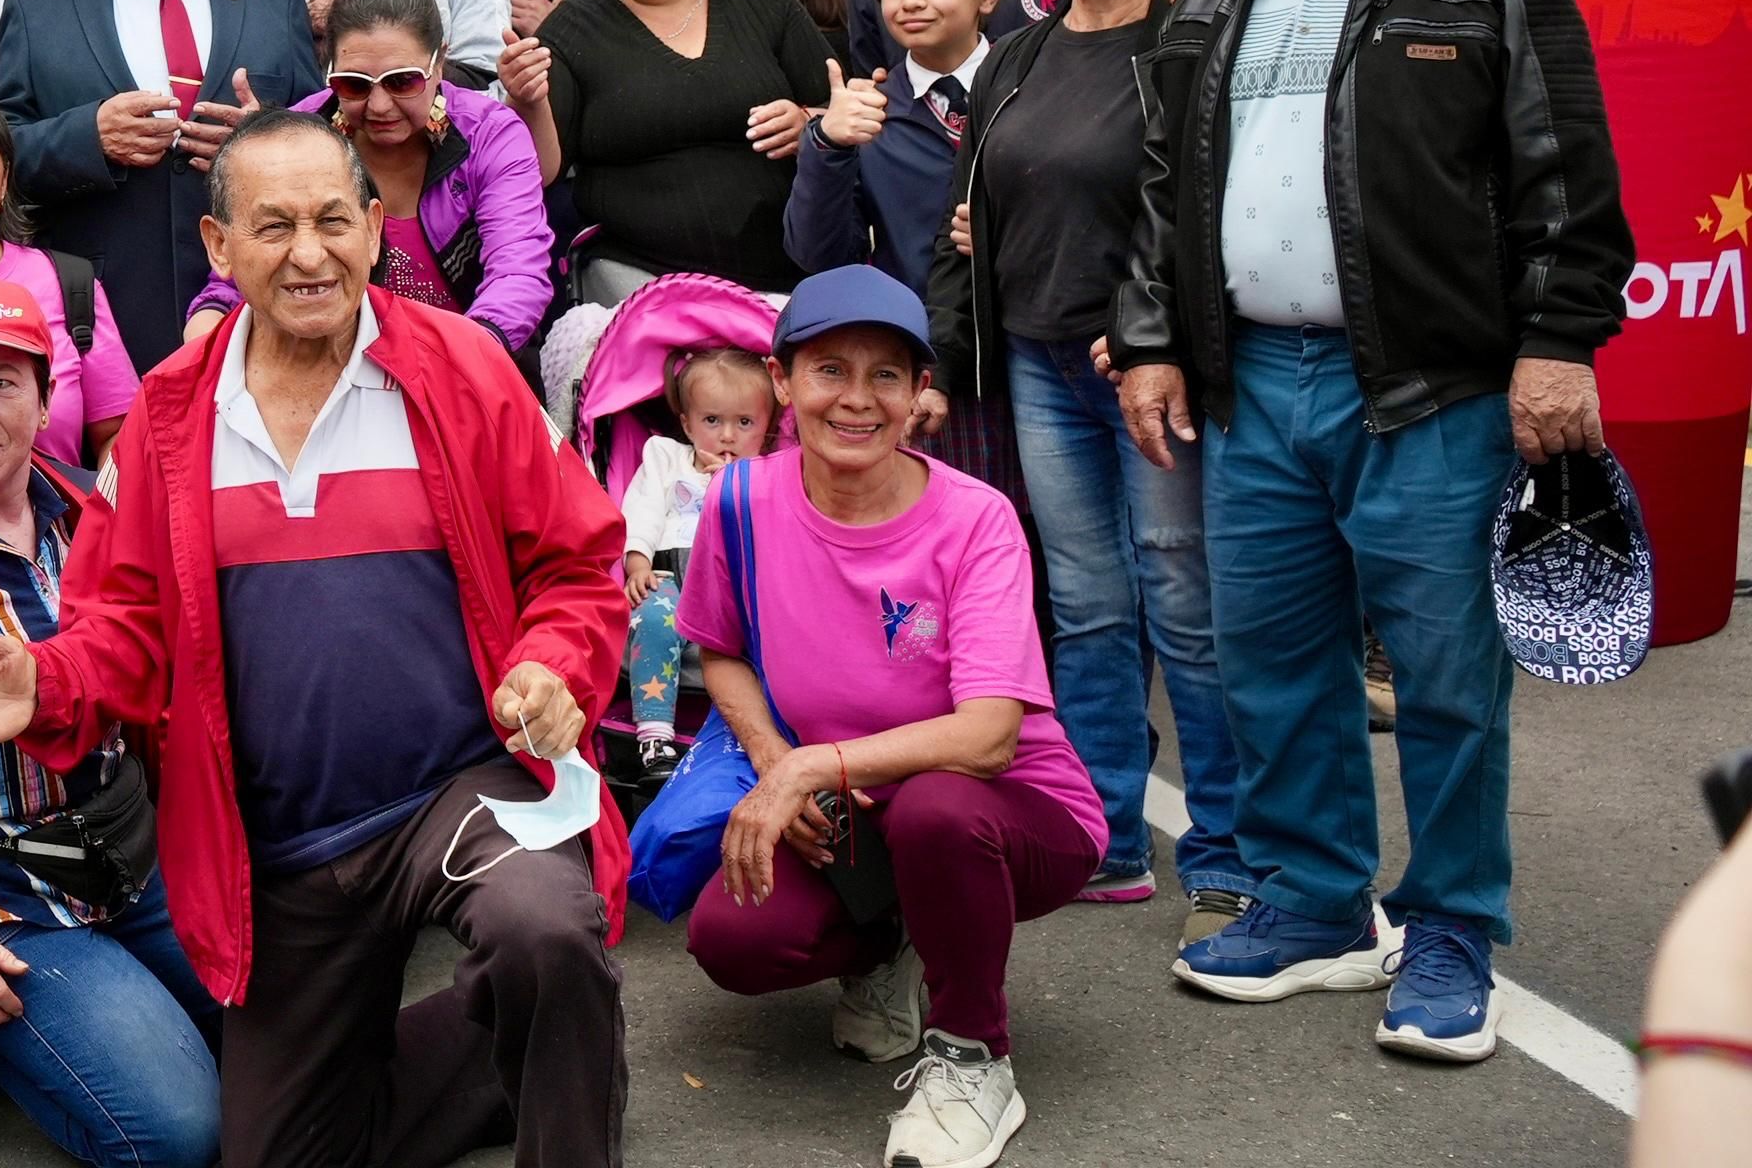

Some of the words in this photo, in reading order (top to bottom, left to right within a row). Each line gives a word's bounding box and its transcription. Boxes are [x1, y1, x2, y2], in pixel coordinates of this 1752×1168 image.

[1506, 619, 1557, 643] BOSS
[1568, 635, 1620, 652] BOSS
[1578, 651, 1621, 665] BOSS
